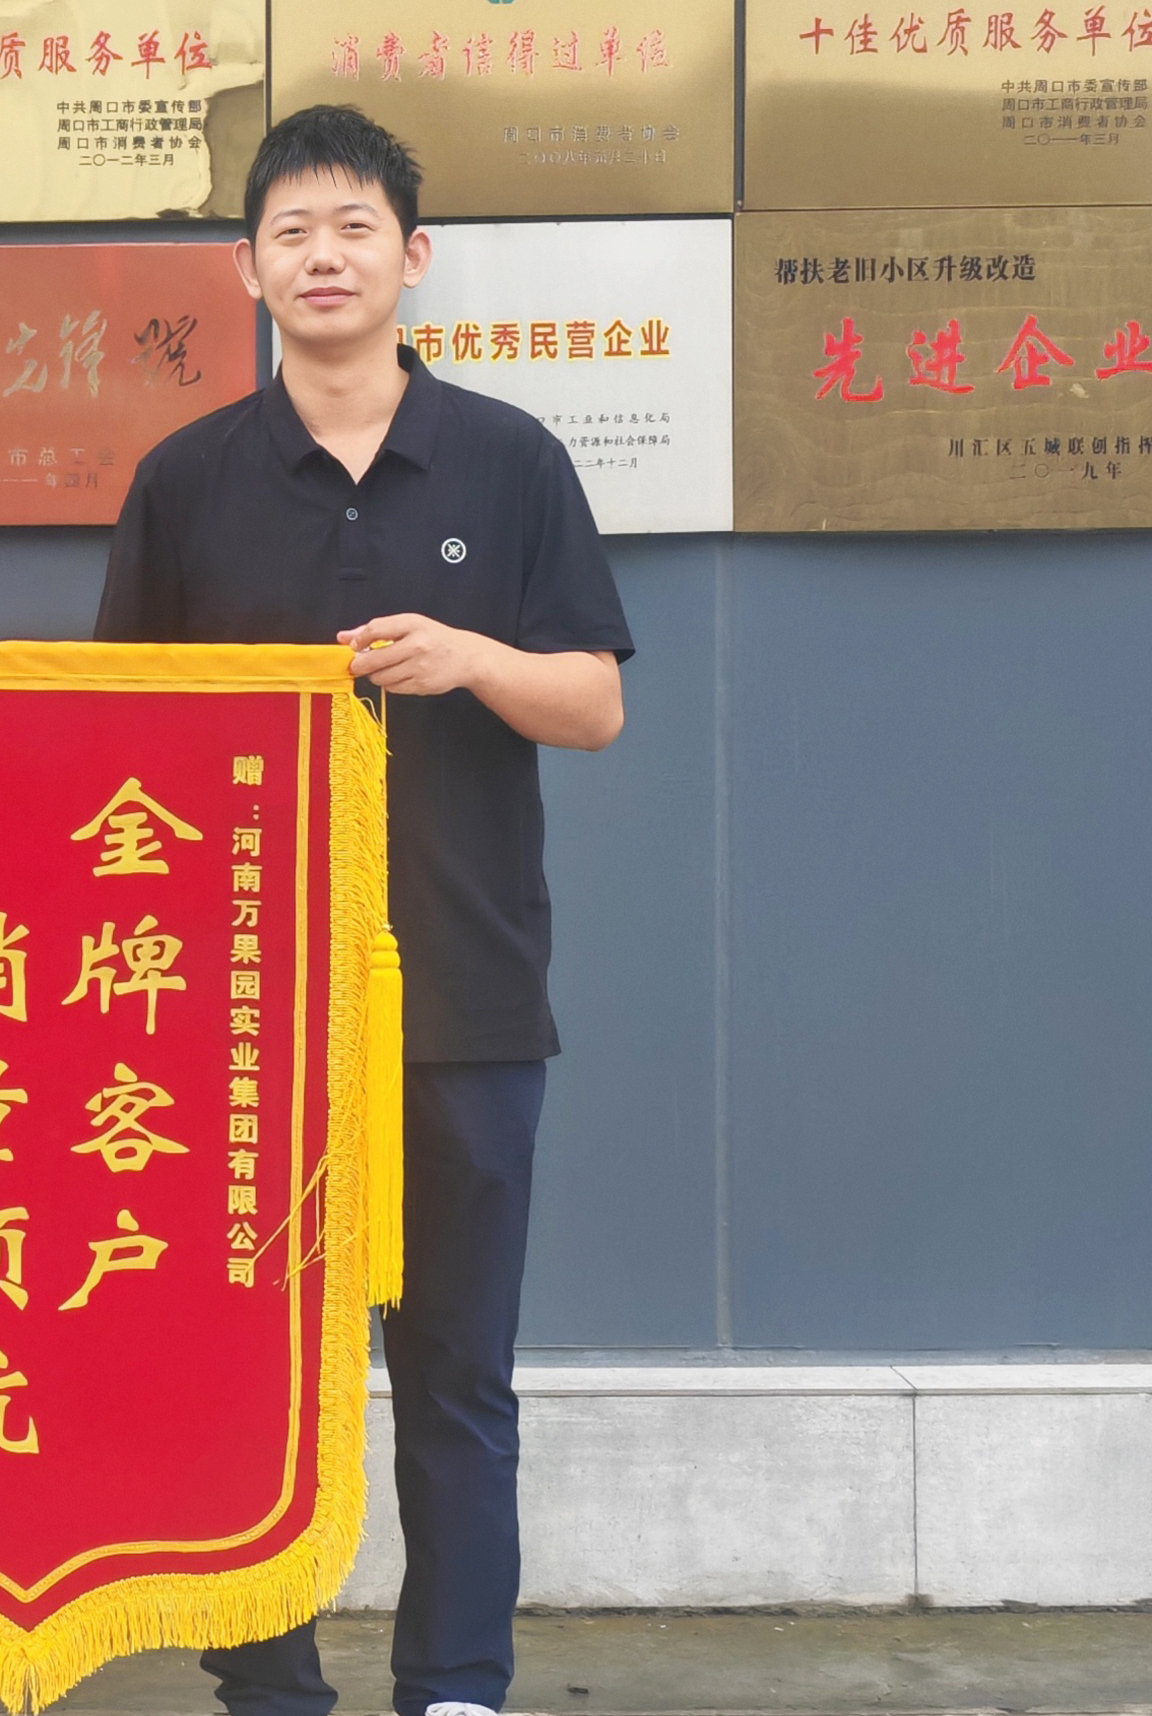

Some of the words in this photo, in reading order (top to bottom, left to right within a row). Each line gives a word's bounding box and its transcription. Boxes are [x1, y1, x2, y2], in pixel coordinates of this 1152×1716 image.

[799, 5, 1152, 56] 十佳优质服务单位
[330, 26, 673, 82] 消费者信得过单位
[1001, 78, 1148, 93] 中共周口市委宣传部
[56, 99, 203, 114] 中共周口市委宣传部
[1001, 96, 1148, 112] 周口市工商行政管理局
[56, 117, 203, 132] 周口市工商行政管理局
[1001, 114, 1147, 130] 周口市消费者协会
[56, 136, 203, 150] 周口市消费者协会
[774, 253, 1037, 284] 帮扶老旧小区升级改造
[396, 320, 671, 363] 市优秀民营企业
[813, 314, 1152, 402] 先进企业
[559, 434, 671, 448] 力资源和社会保障局
[58, 777, 203, 1311] 金牌客户
